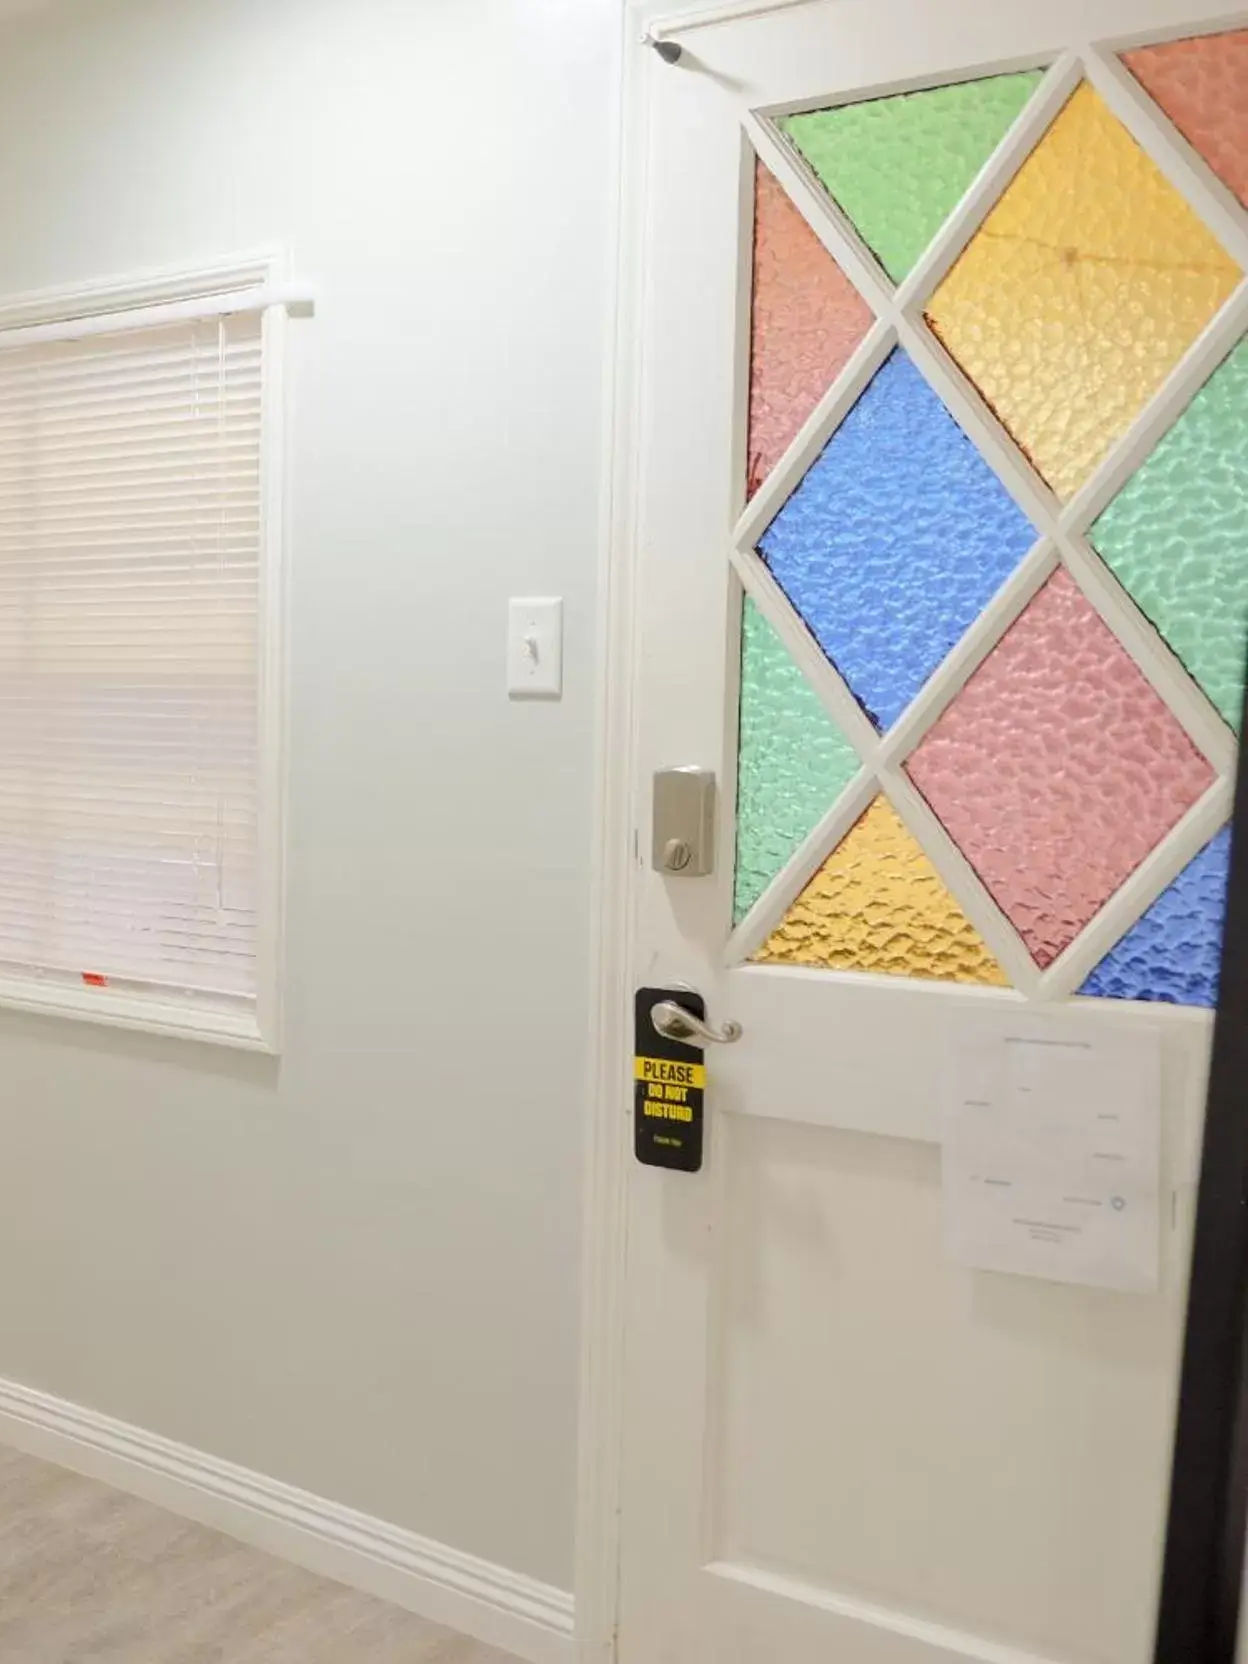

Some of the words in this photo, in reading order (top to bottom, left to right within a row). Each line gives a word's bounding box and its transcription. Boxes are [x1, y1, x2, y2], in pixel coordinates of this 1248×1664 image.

[643, 1060, 694, 1084] PLEASE
[648, 1083, 663, 1098] DO
[665, 1084, 688, 1102] NOT
[644, 1100, 693, 1122] DISTURB
